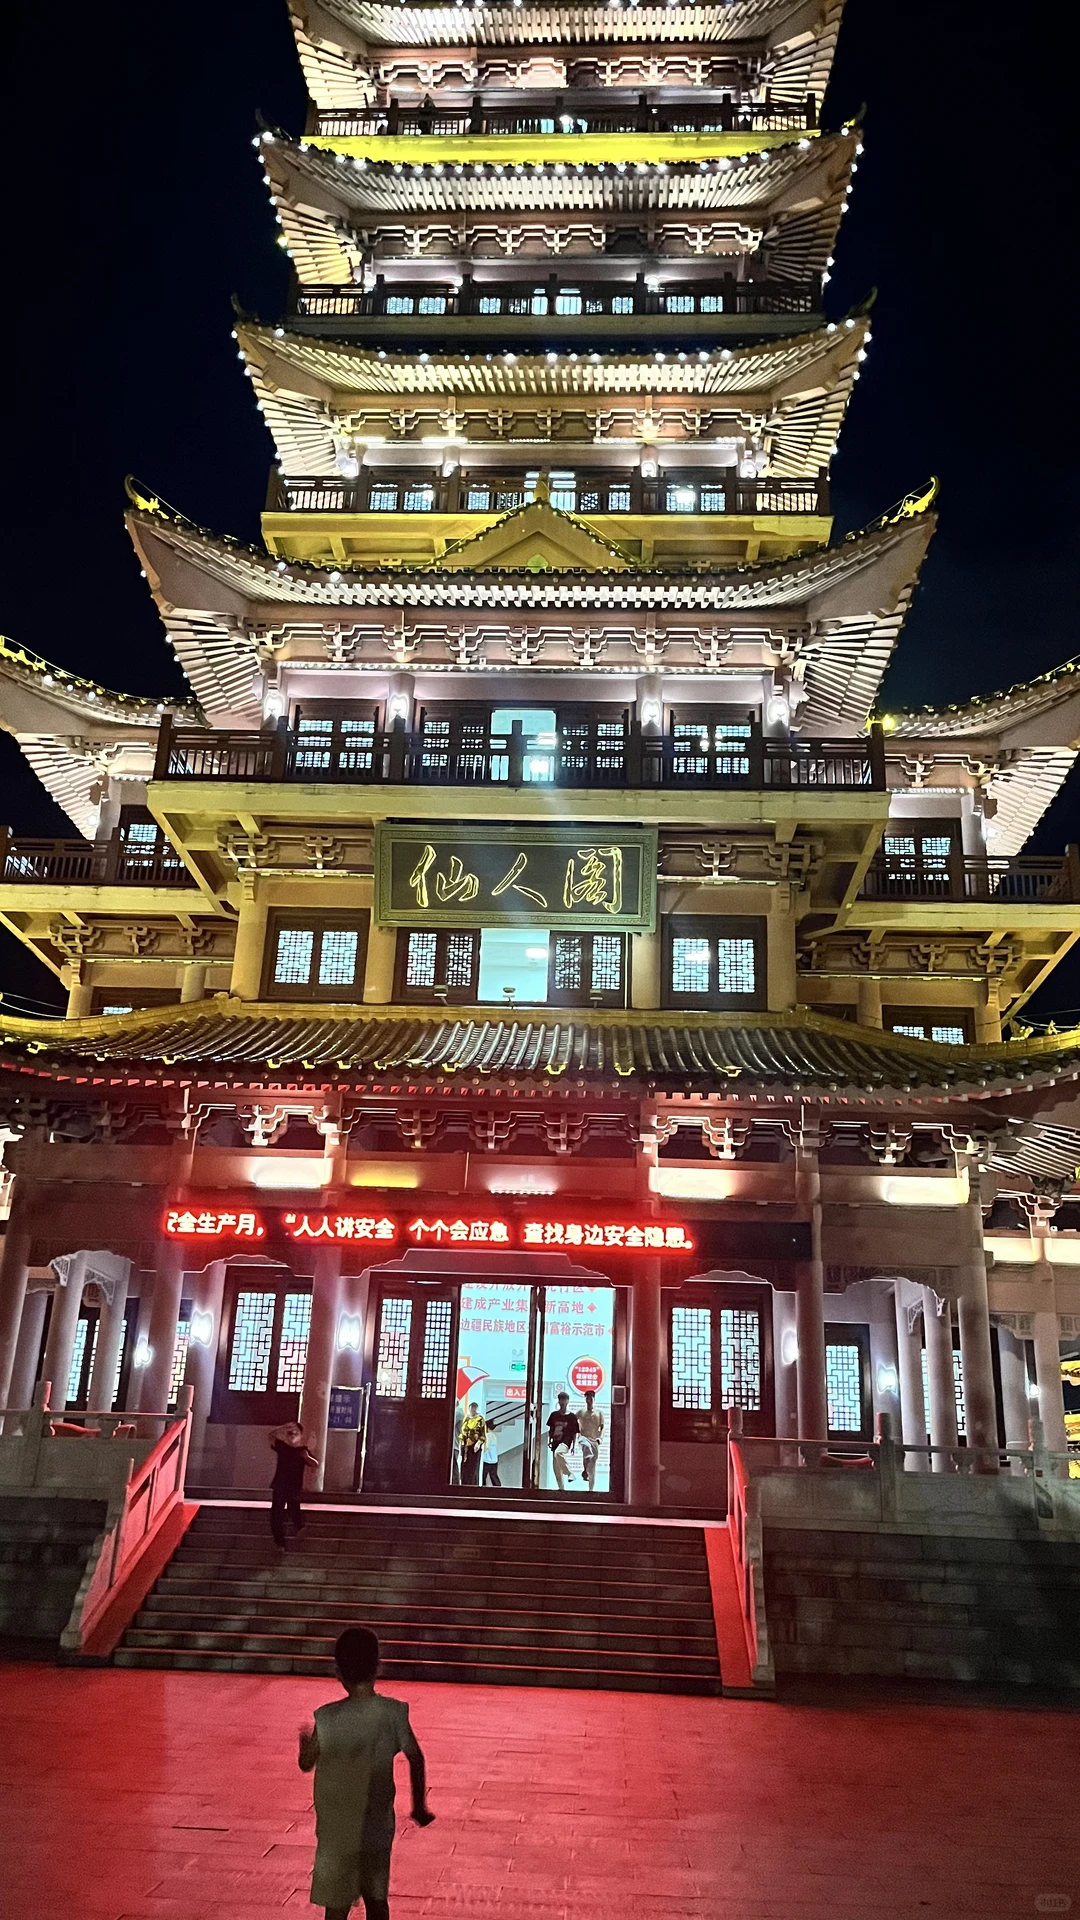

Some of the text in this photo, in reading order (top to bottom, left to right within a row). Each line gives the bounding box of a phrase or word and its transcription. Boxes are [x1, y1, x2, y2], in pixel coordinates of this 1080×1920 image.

[408, 1218, 509, 1242] 个个会应急
[462, 1297, 528, 1312] 建成产业集
[545, 1321, 605, 1337] 富裕示范市
